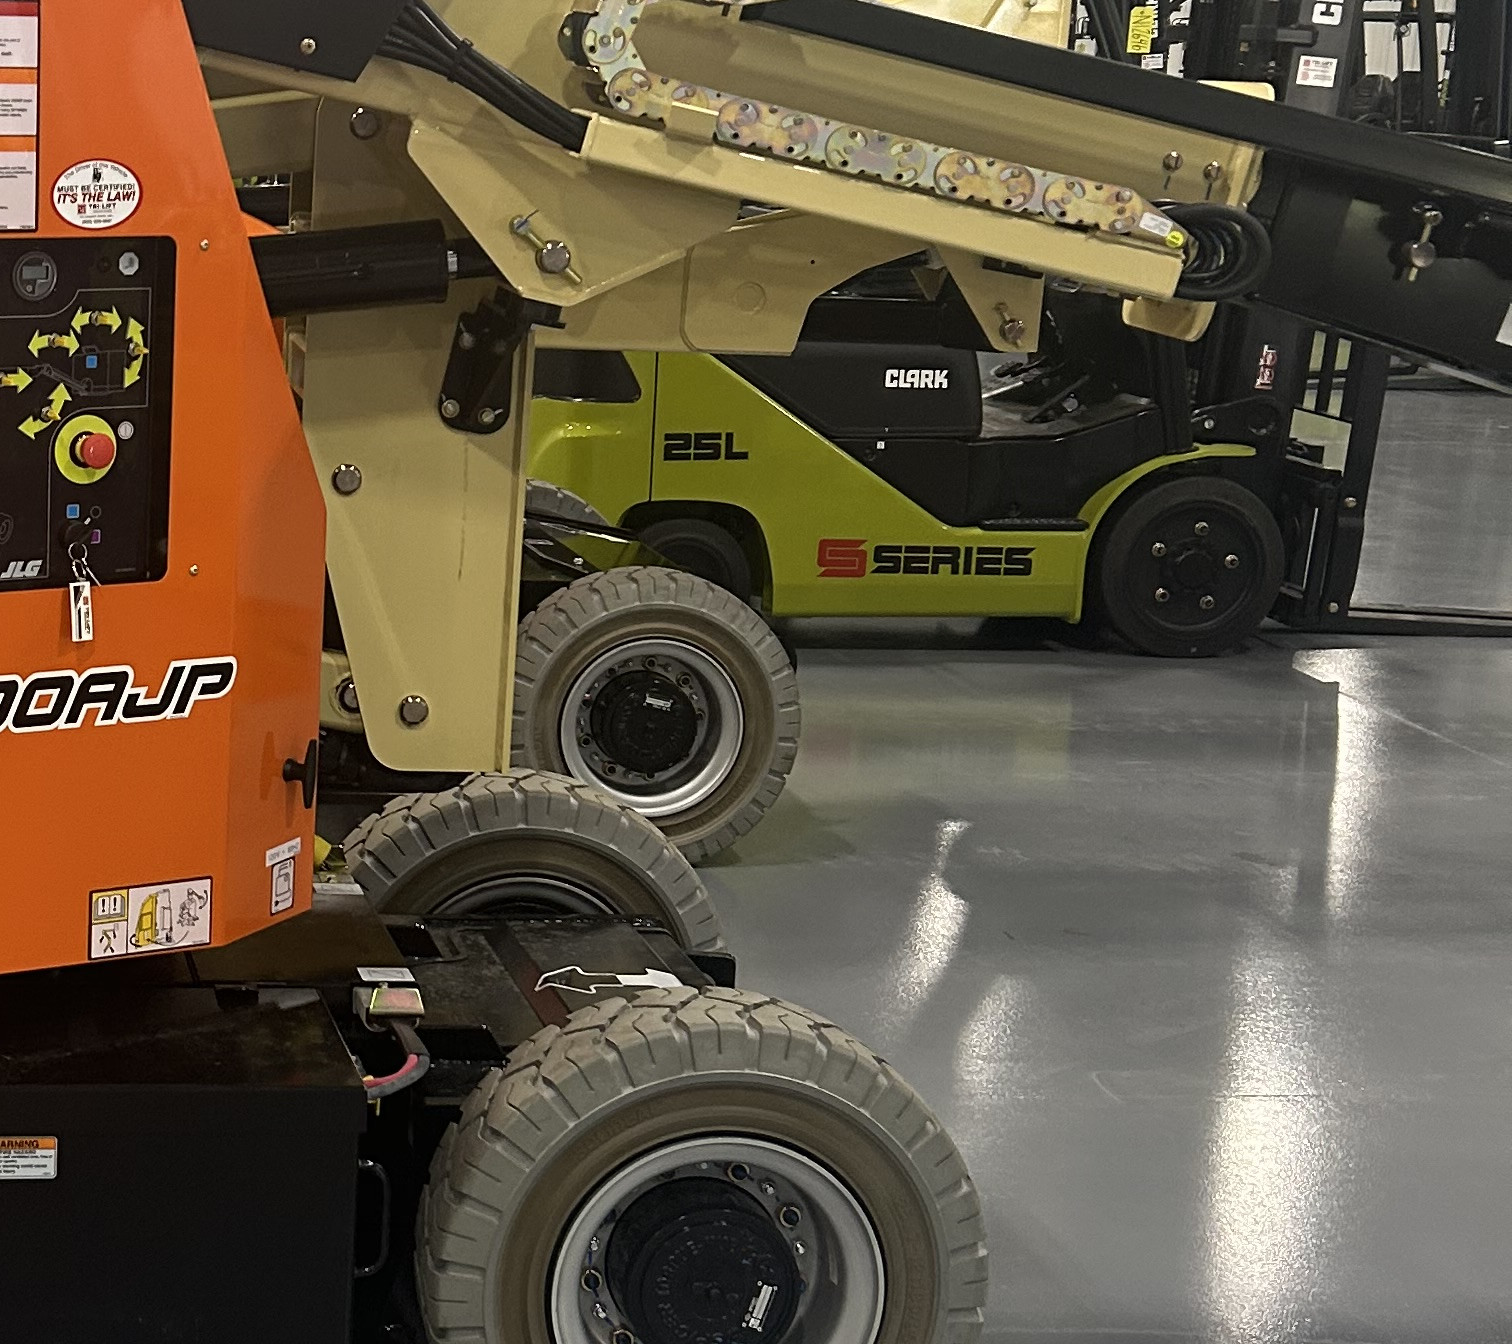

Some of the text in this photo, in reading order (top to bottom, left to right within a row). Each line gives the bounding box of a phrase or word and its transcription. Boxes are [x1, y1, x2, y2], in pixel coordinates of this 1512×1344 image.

[56, 185, 79, 193] MUST
[93, 183, 135, 192] CERTIFIED!
[56, 191, 136, 204] IT'S THE LAW!
[884, 369, 949, 389] CLARK
[663, 432, 749, 461] 25L
[816, 538, 1037, 578] S SERIES
[0, 560, 44, 579] JLG
